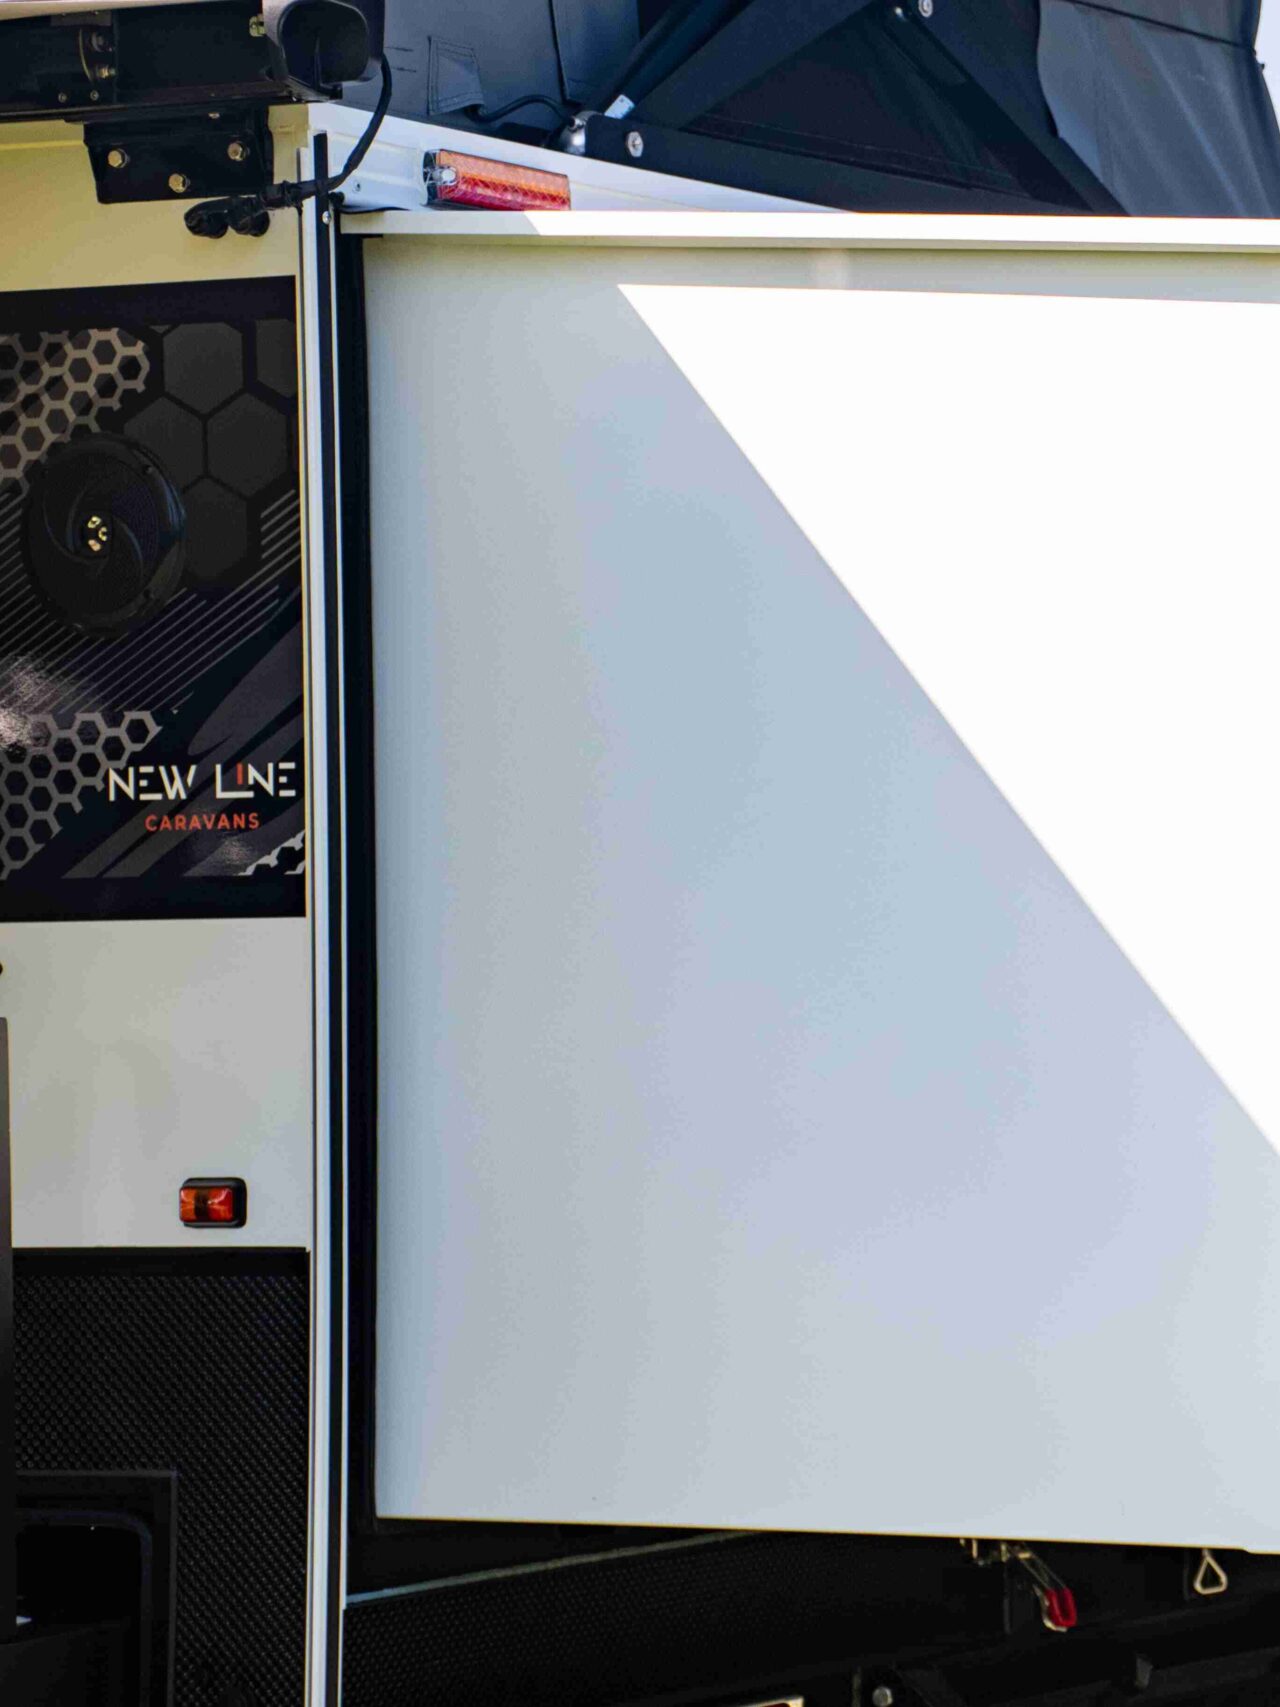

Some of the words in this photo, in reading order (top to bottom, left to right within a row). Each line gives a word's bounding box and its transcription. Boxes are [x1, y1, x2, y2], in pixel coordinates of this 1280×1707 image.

[109, 764, 197, 801] NEW
[215, 762, 296, 799] LINE
[144, 812, 260, 832] CARAVANS
